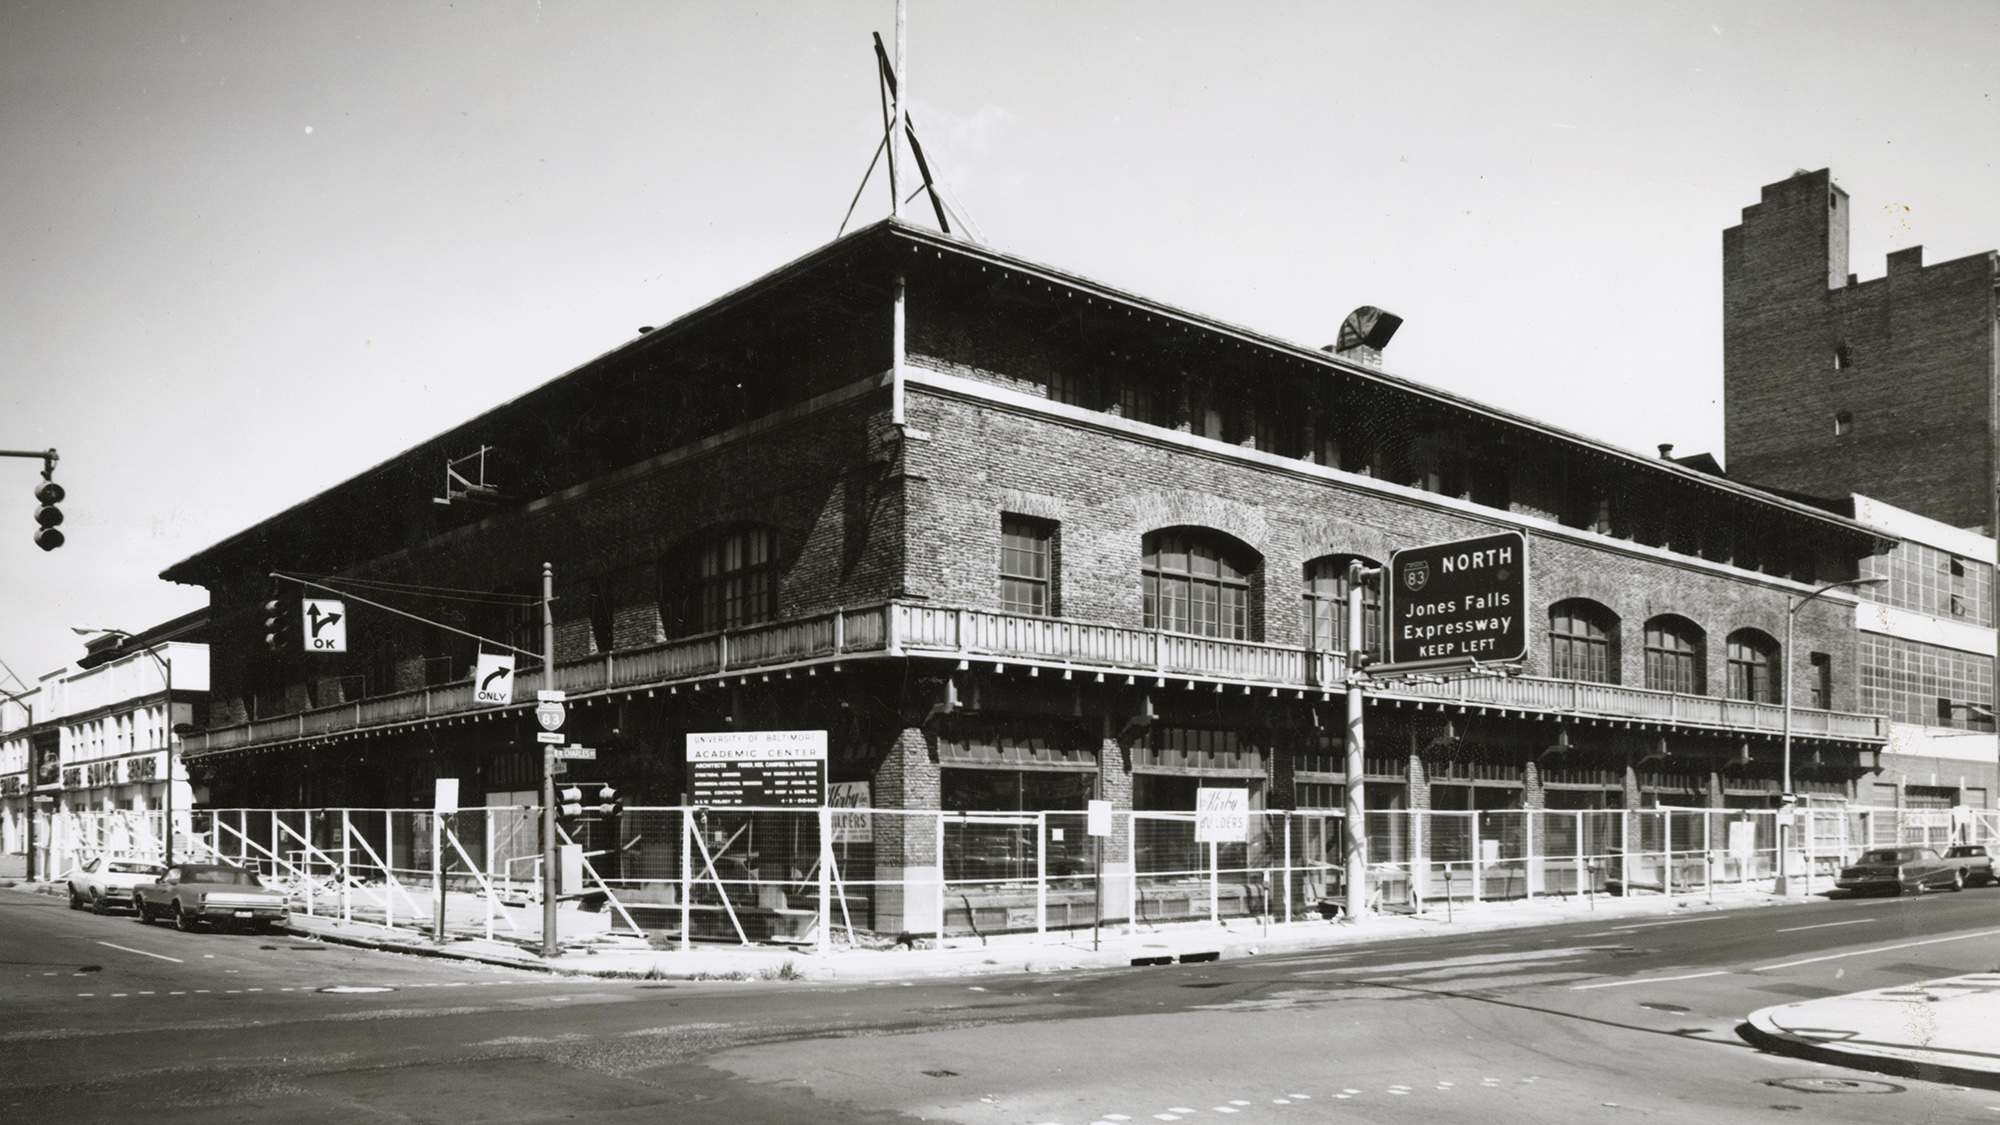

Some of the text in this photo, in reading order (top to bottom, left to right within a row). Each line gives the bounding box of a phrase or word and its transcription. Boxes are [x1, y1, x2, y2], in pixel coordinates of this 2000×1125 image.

[1442, 546, 1512, 573] NORTH
[1408, 571, 1425, 586] 83
[1405, 592, 1511, 618] Jones Falls
[1404, 616, 1512, 640] Expressway
[313, 639, 335, 649] OK
[1420, 638, 1495, 657] KEEP LEFT
[478, 691, 507, 701] ONLY
[542, 713, 560, 725] 83
[694, 733, 815, 743] UNIVERSITY OF BALTIMORE
[564, 749, 590, 757] CHARLES
[695, 750, 757, 758] ACADEMIC
